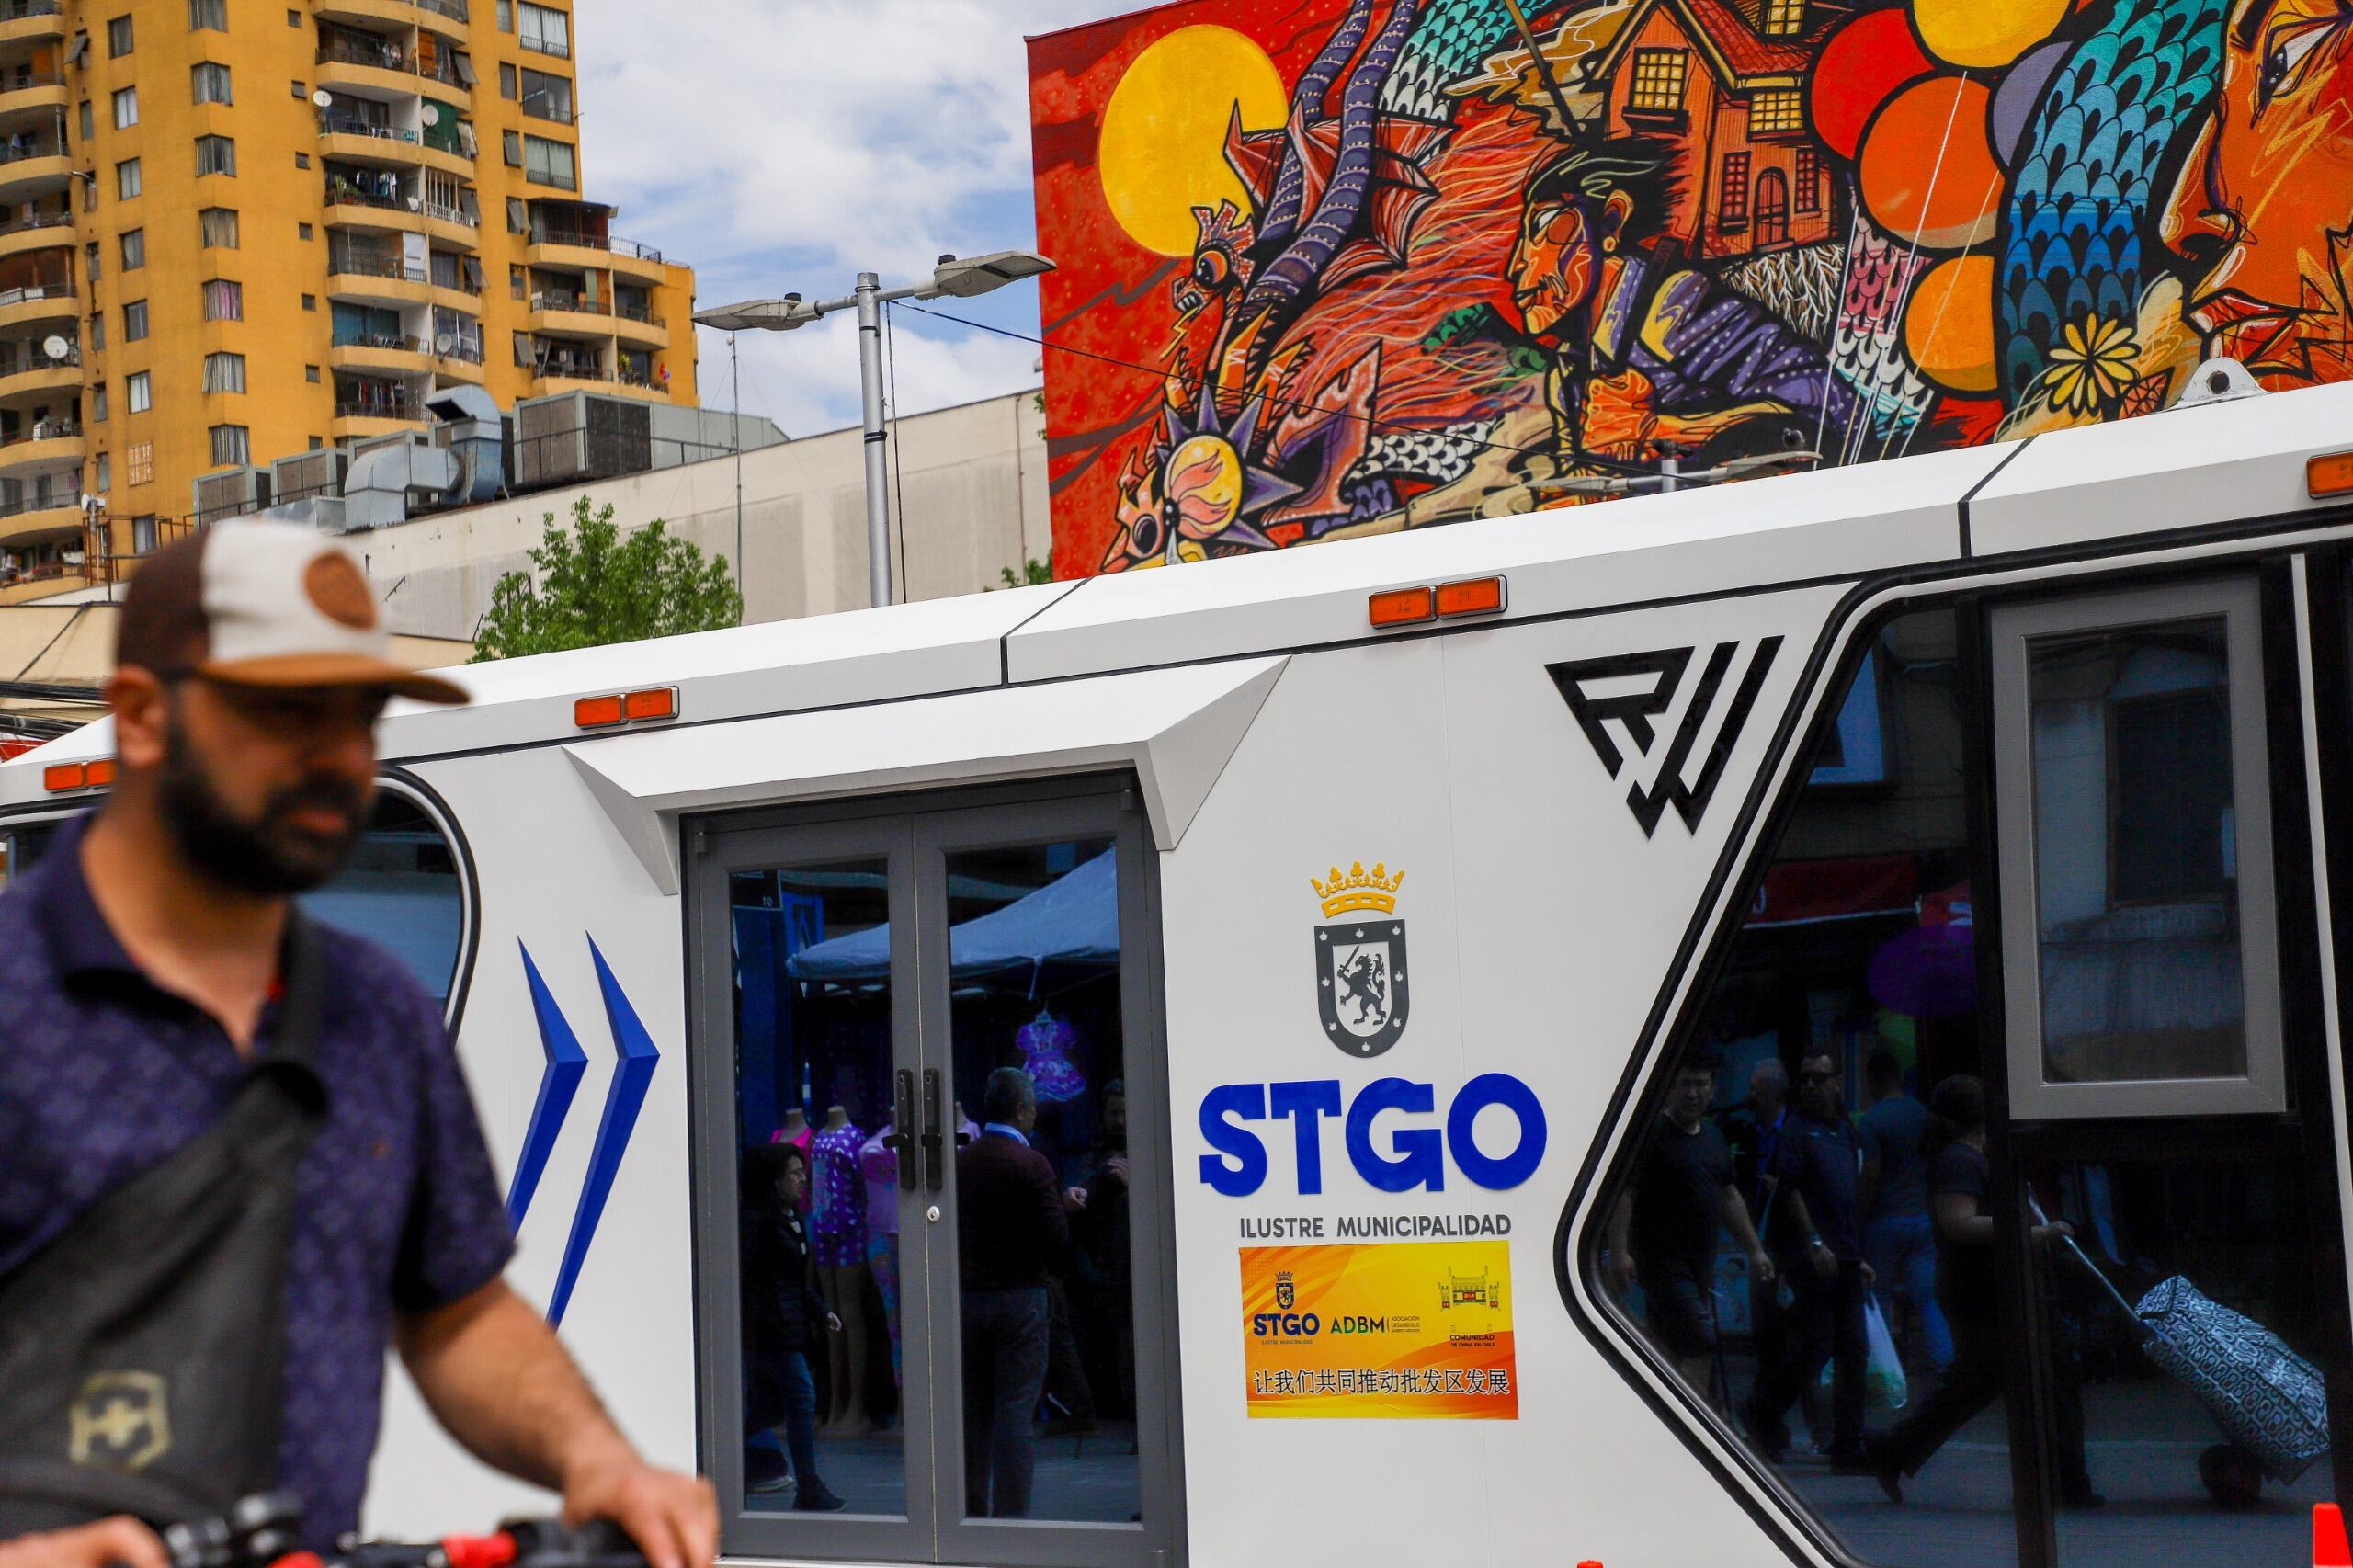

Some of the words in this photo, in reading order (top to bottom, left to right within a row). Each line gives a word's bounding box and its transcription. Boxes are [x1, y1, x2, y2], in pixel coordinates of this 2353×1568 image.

[1199, 1073, 1547, 1197] STGO
[1240, 1217, 1324, 1238] ILUSTRE
[1336, 1214, 1512, 1237] MUNICIPALIDAD
[1253, 1313, 1320, 1335] STGO
[1330, 1316, 1385, 1334] ADBM
[1254, 1369, 1510, 1394] 让我们共同推动批发区发展
